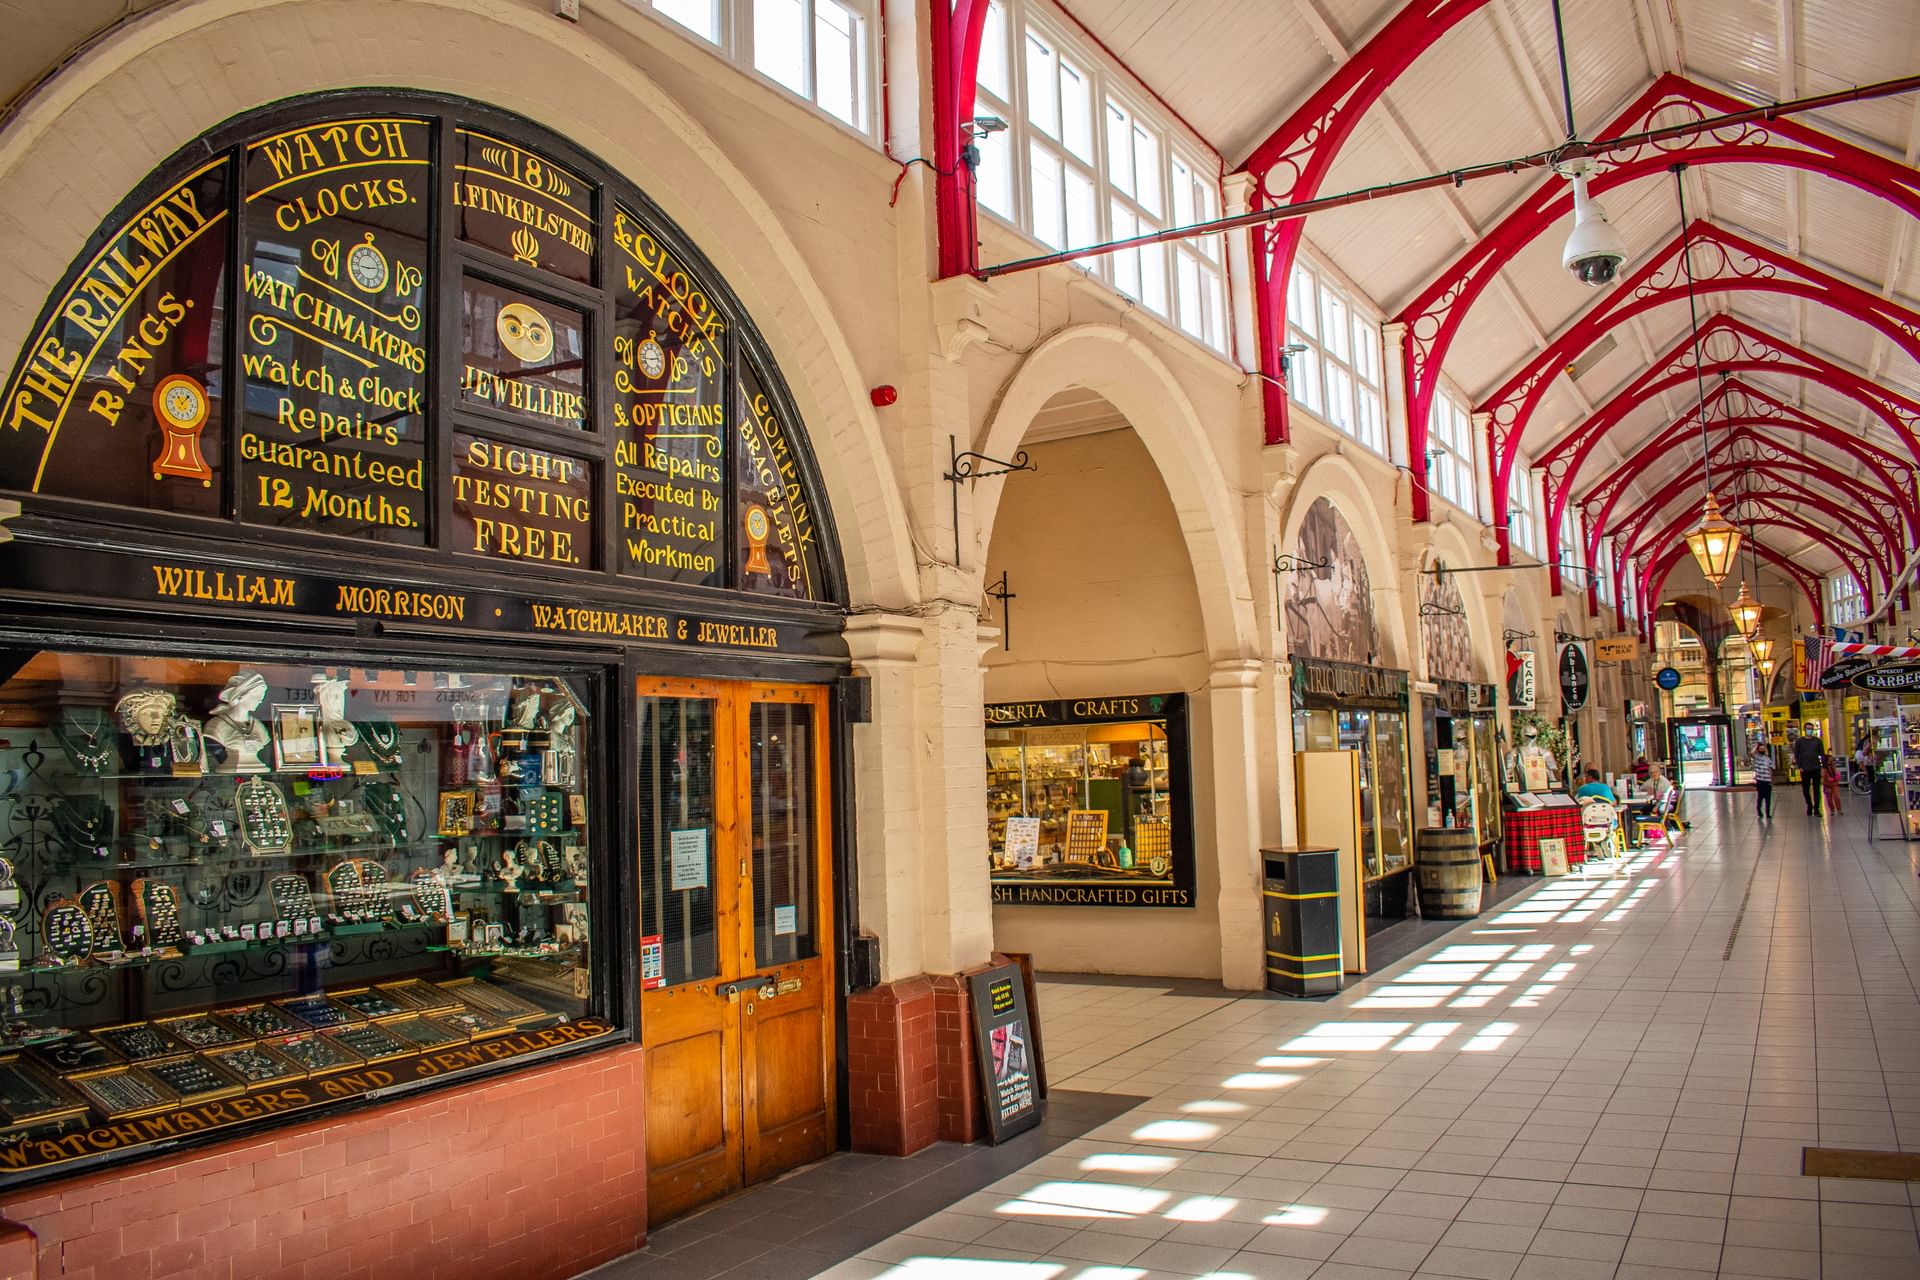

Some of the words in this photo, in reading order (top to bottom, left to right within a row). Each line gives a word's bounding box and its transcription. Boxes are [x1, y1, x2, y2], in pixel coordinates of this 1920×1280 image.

[264, 122, 409, 180] WATCH
[510, 149, 543, 188] 18
[275, 178, 417, 232] CLOCKS.
[614, 213, 634, 249] &
[634, 232, 727, 344] CLOCK
[9, 336, 83, 432] THE
[62, 187, 208, 340] RAILWAY
[244, 264, 427, 375] WATCHMAKERS
[624, 265, 716, 386] WATCHES.
[89, 291, 195, 427] RINGS.
[242, 352, 335, 398] Watch
[338, 378, 354, 398] &
[358, 376, 423, 416] Clock
[460, 365, 588, 422] JEWELLERS
[614, 403, 629, 428] &
[632, 402, 724, 427] OPTICIANS
[278, 398, 400, 446] Repairs
[241, 433, 425, 492] Guaranteed
[467, 441, 573, 485] SIGHT
[614, 440, 638, 469] All
[644, 443, 721, 484] Repairs
[754, 393, 815, 552] COMPANY.
[258, 475, 294, 509] 12
[302, 485, 419, 529] Months.
[453, 475, 591, 523] TESTING
[616, 473, 695, 508] Executed
[701, 491, 719, 513] By
[740, 417, 801, 591] BRACELETS.
[472, 517, 581, 565] FREE.
[624, 503, 716, 543] Practical
[627, 538, 716, 574] Workmen
[153, 565, 297, 607] WILLIAM
[336, 585, 466, 622] MORRISON
[532, 604, 669, 640] WATCHMAKER
[677, 619, 688, 641] &
[697, 621, 778, 649] JEWELLER
[1525, 660, 1533, 696] CAFE
[1568, 644, 1578, 700] Ambiance
[1821, 672, 1844, 686] Arcade
[1844, 663, 1871, 677] Barbers
[1074, 699, 1140, 717] CRAFTS
[1019, 888, 1137, 903] HANDCRAFTED
[1142, 889, 1188, 904] GIFTS
[0, 1088, 311, 1168] WATCHMAKERS
[318, 1069, 395, 1099] AND
[416, 1019, 615, 1076] JEWELLERS.
